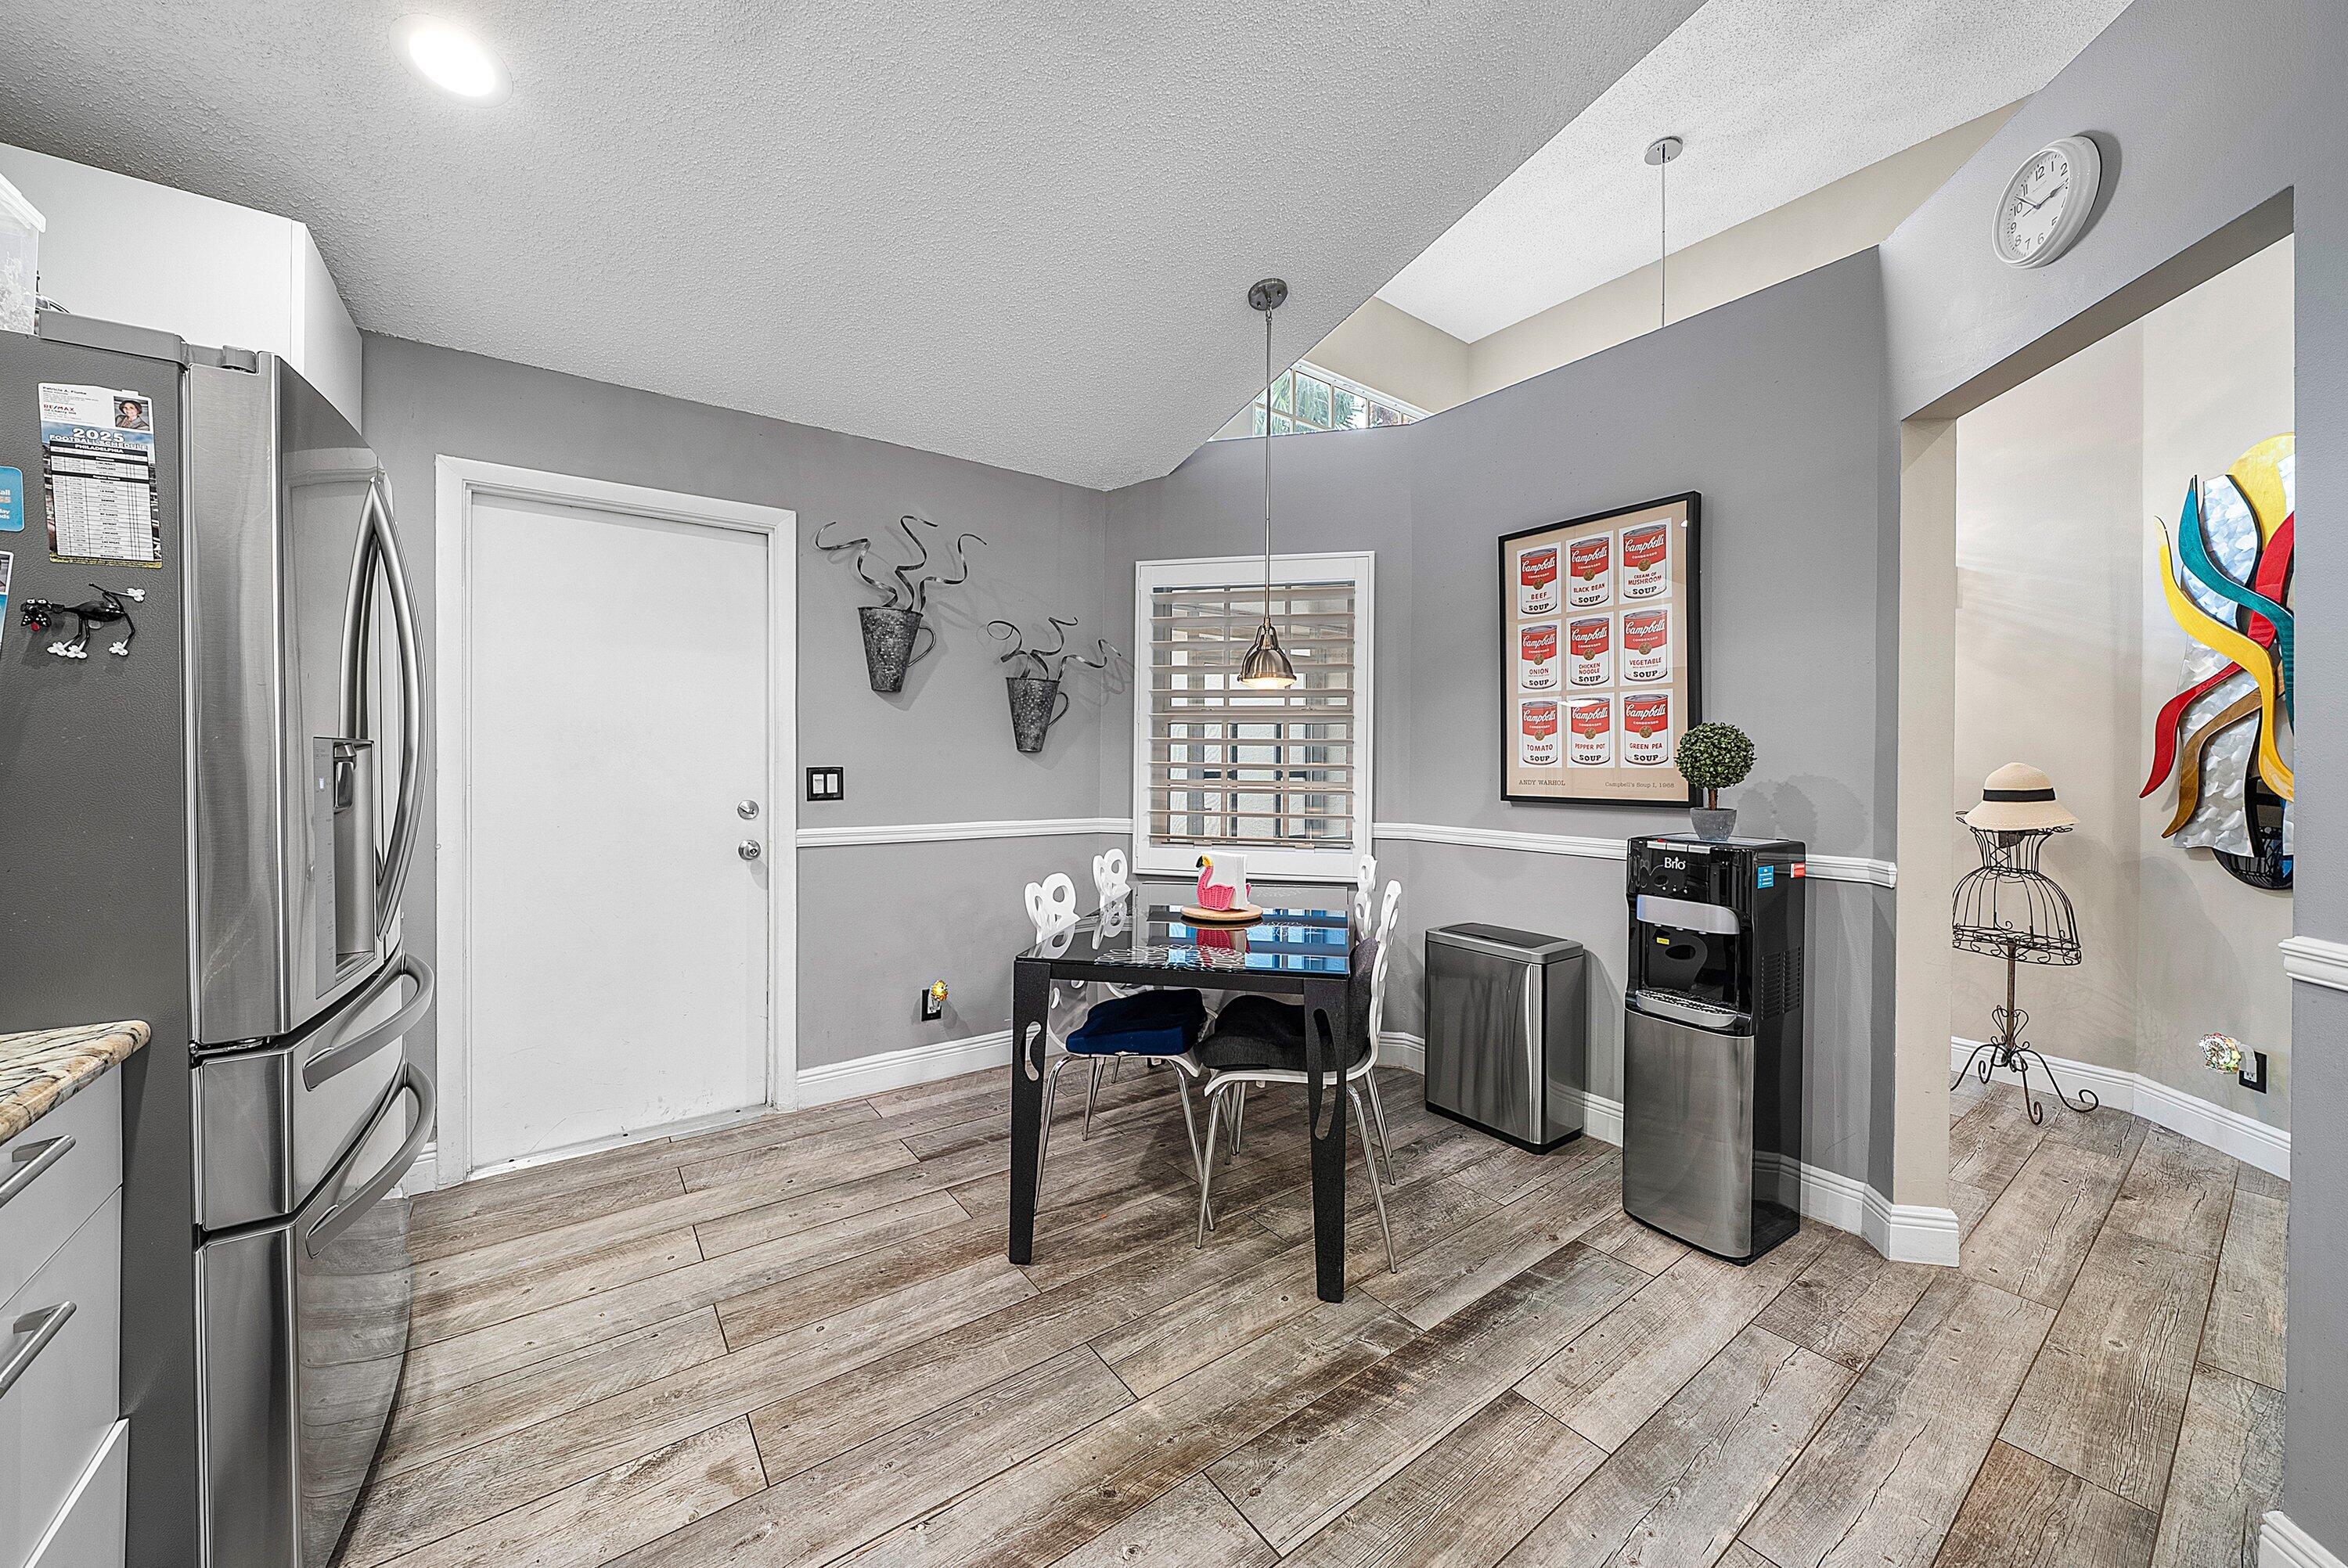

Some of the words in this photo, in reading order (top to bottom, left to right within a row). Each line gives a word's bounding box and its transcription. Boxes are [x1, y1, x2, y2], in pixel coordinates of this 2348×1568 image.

[2035, 166, 2044, 181] 12
[2061, 163, 2068, 177] 2
[2022, 184, 2029, 196] 11
[2013, 202, 2022, 217] 10
[2010, 222, 2017, 235] 9
[2015, 235, 2022, 247] 8
[2025, 238, 2031, 250] 7
[2038, 232, 2044, 245] 6
[49, 434, 97, 444] FOOTBALL
[72, 428, 124, 443] 2025
[74, 444, 124, 454] PHILADELPHIA
[1628, 575, 1662, 585] MUSHROOM
[1591, 582, 1605, 592] BEAN
[1633, 585, 1657, 595] SOUP
[1529, 602, 1550, 611] SOUP
[1630, 657, 1662, 666] VEGETABLE
[1664, 857, 1686, 870] Brio
